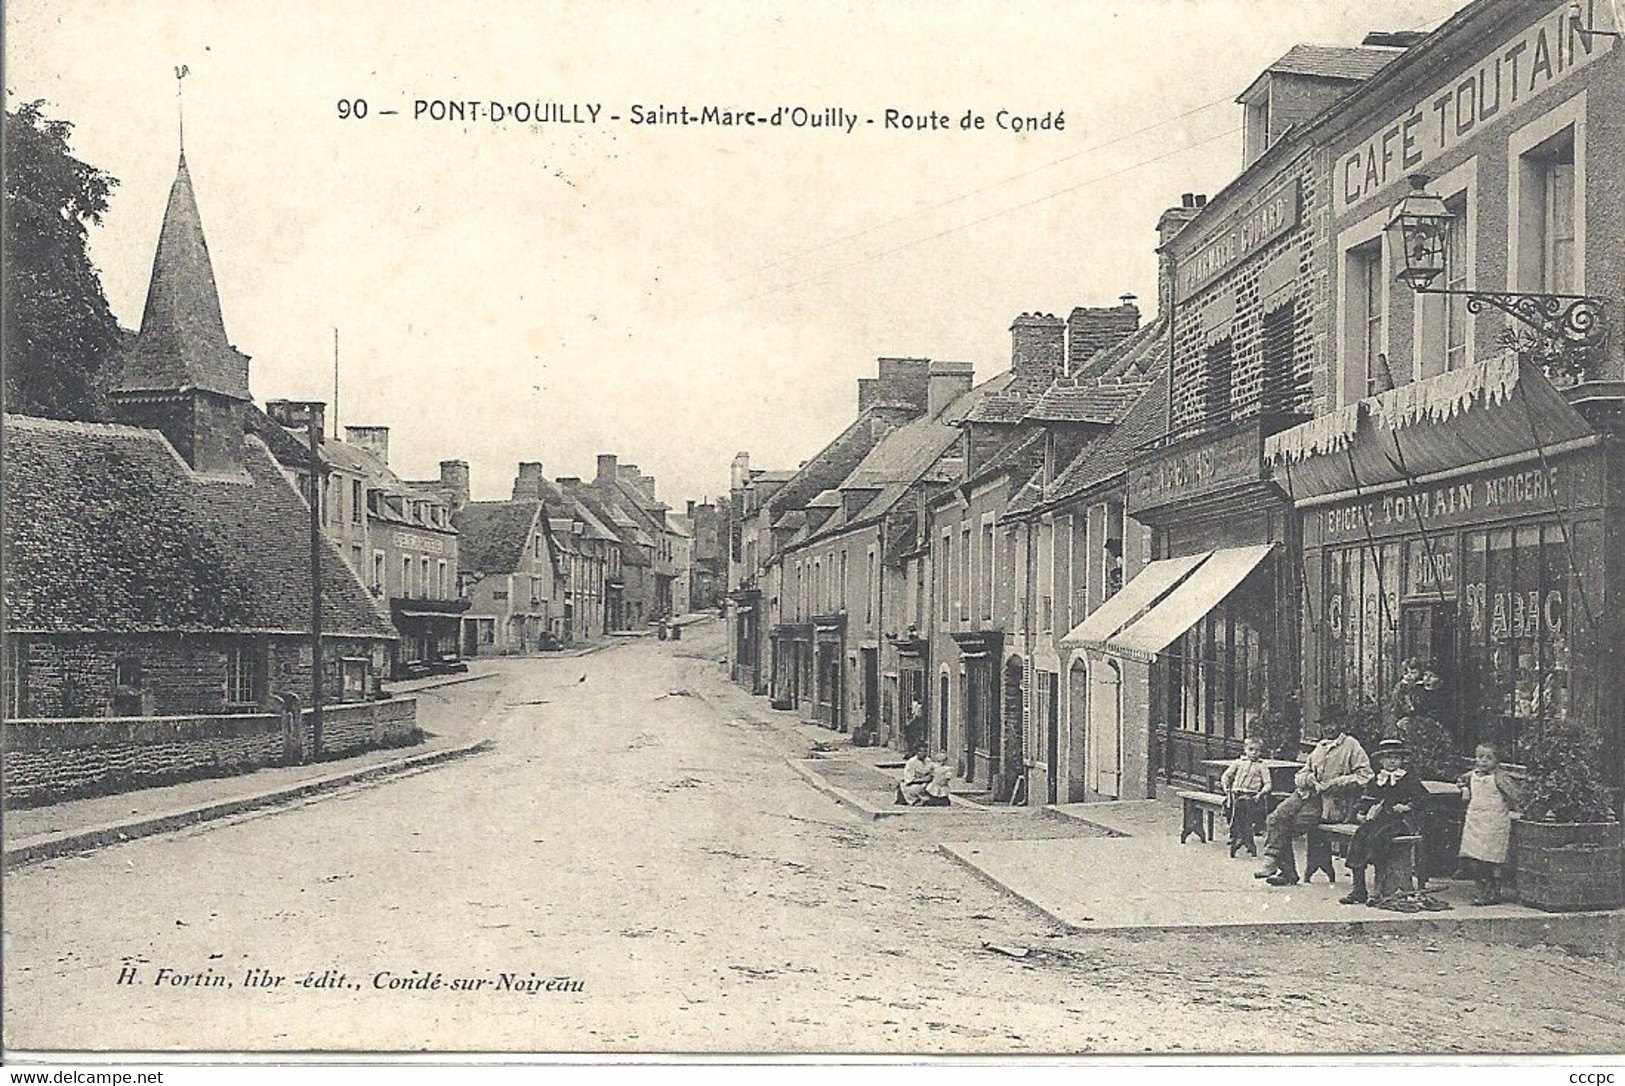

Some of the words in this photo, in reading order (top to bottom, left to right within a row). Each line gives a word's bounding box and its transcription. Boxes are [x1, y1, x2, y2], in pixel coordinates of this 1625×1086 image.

[1345, 105, 1423, 205] CAFÉ
[1433, 0, 1595, 149] TOUTAIN
[1465, 582, 1562, 639] TABAC
